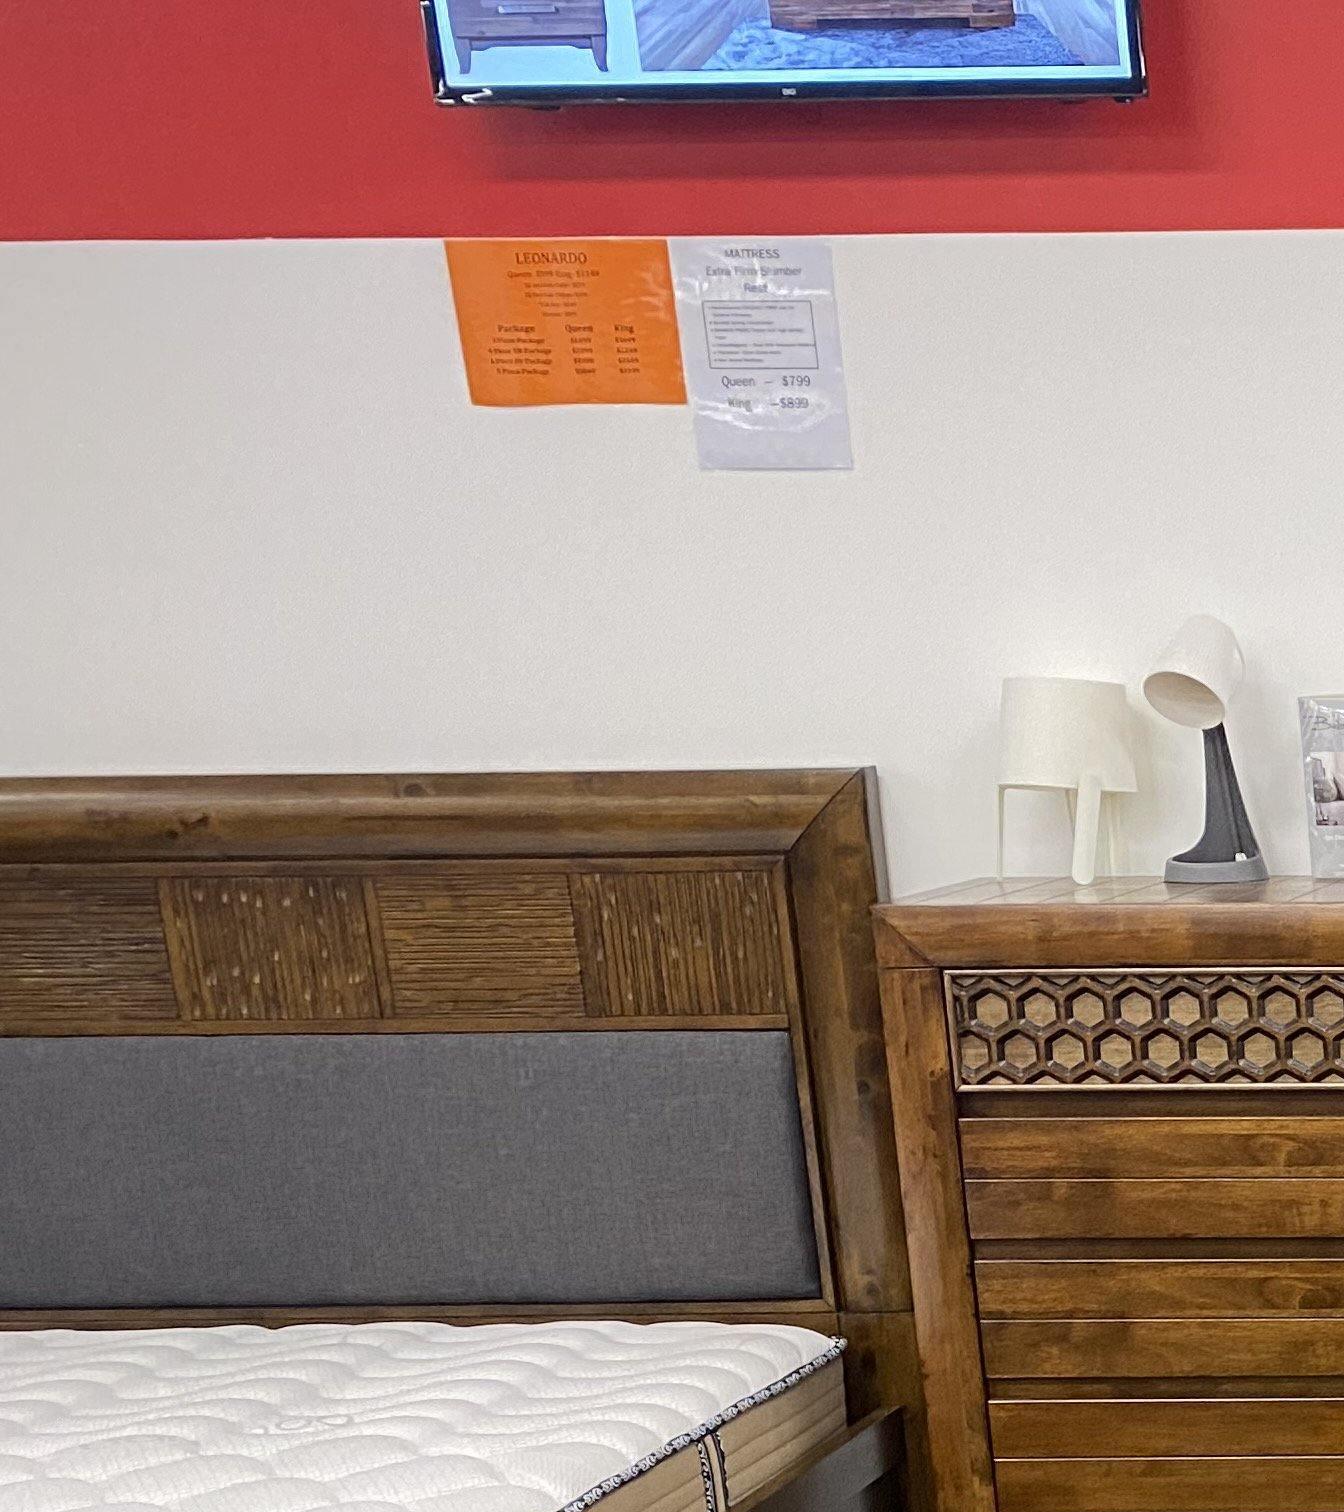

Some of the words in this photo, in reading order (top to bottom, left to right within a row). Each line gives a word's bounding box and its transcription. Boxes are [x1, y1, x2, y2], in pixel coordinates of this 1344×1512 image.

[515, 252, 588, 264] LEONARDO
[725, 249, 780, 258] MATTRESS
[706, 266, 731, 276] Extra
[498, 324, 535, 333] Package
[565, 324, 593, 333] Queen
[614, 324, 634, 334] King
[722, 375, 756, 388] Queen
[782, 375, 811, 387] $799
